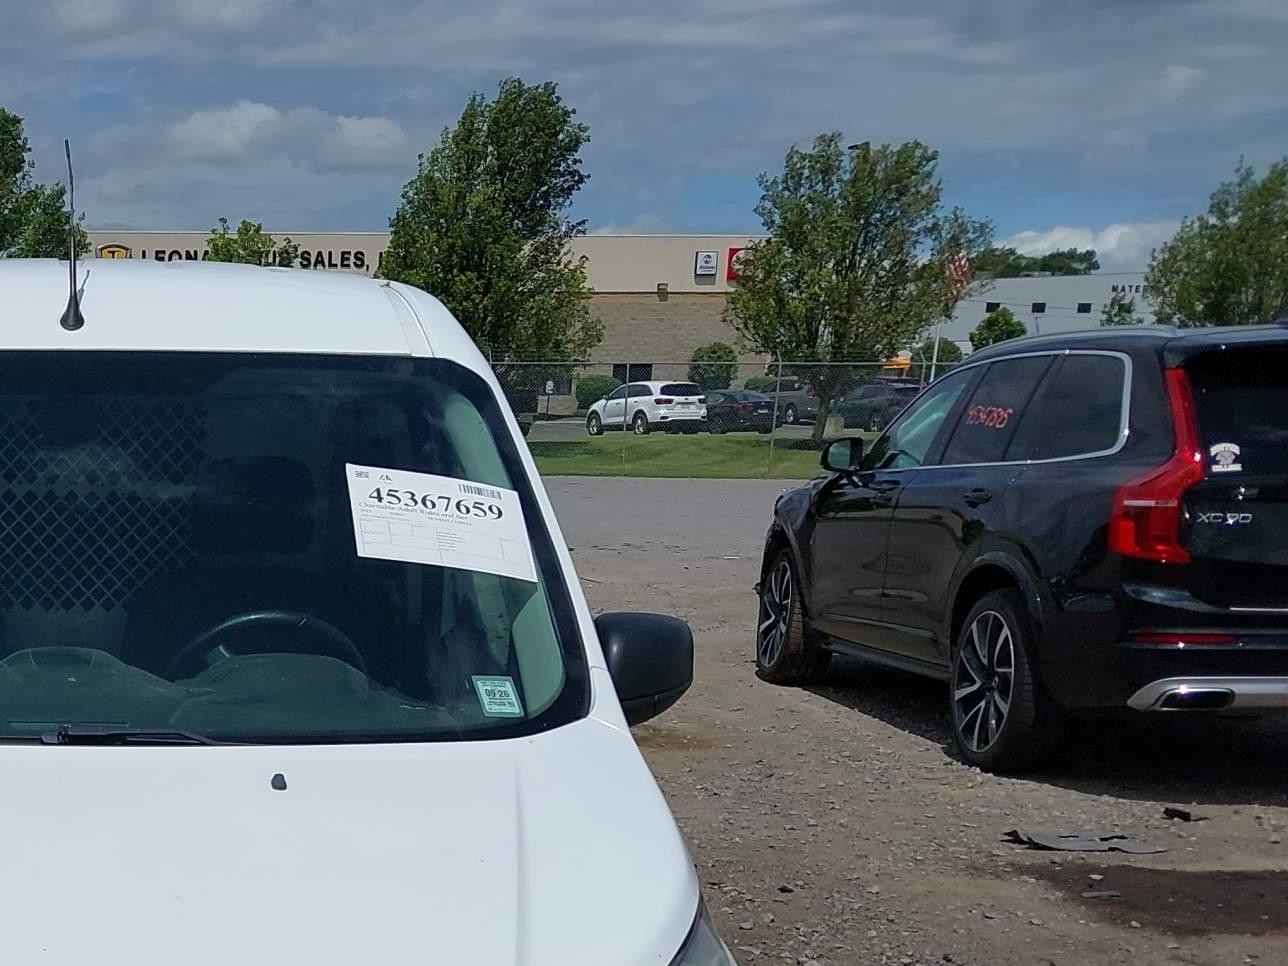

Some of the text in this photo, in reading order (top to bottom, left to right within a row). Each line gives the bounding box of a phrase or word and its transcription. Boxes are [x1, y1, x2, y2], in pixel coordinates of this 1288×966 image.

[299, 250, 370, 271] SALES,
[368, 486, 504, 521] 45367659
[1196, 512, 1253, 524] XC90
